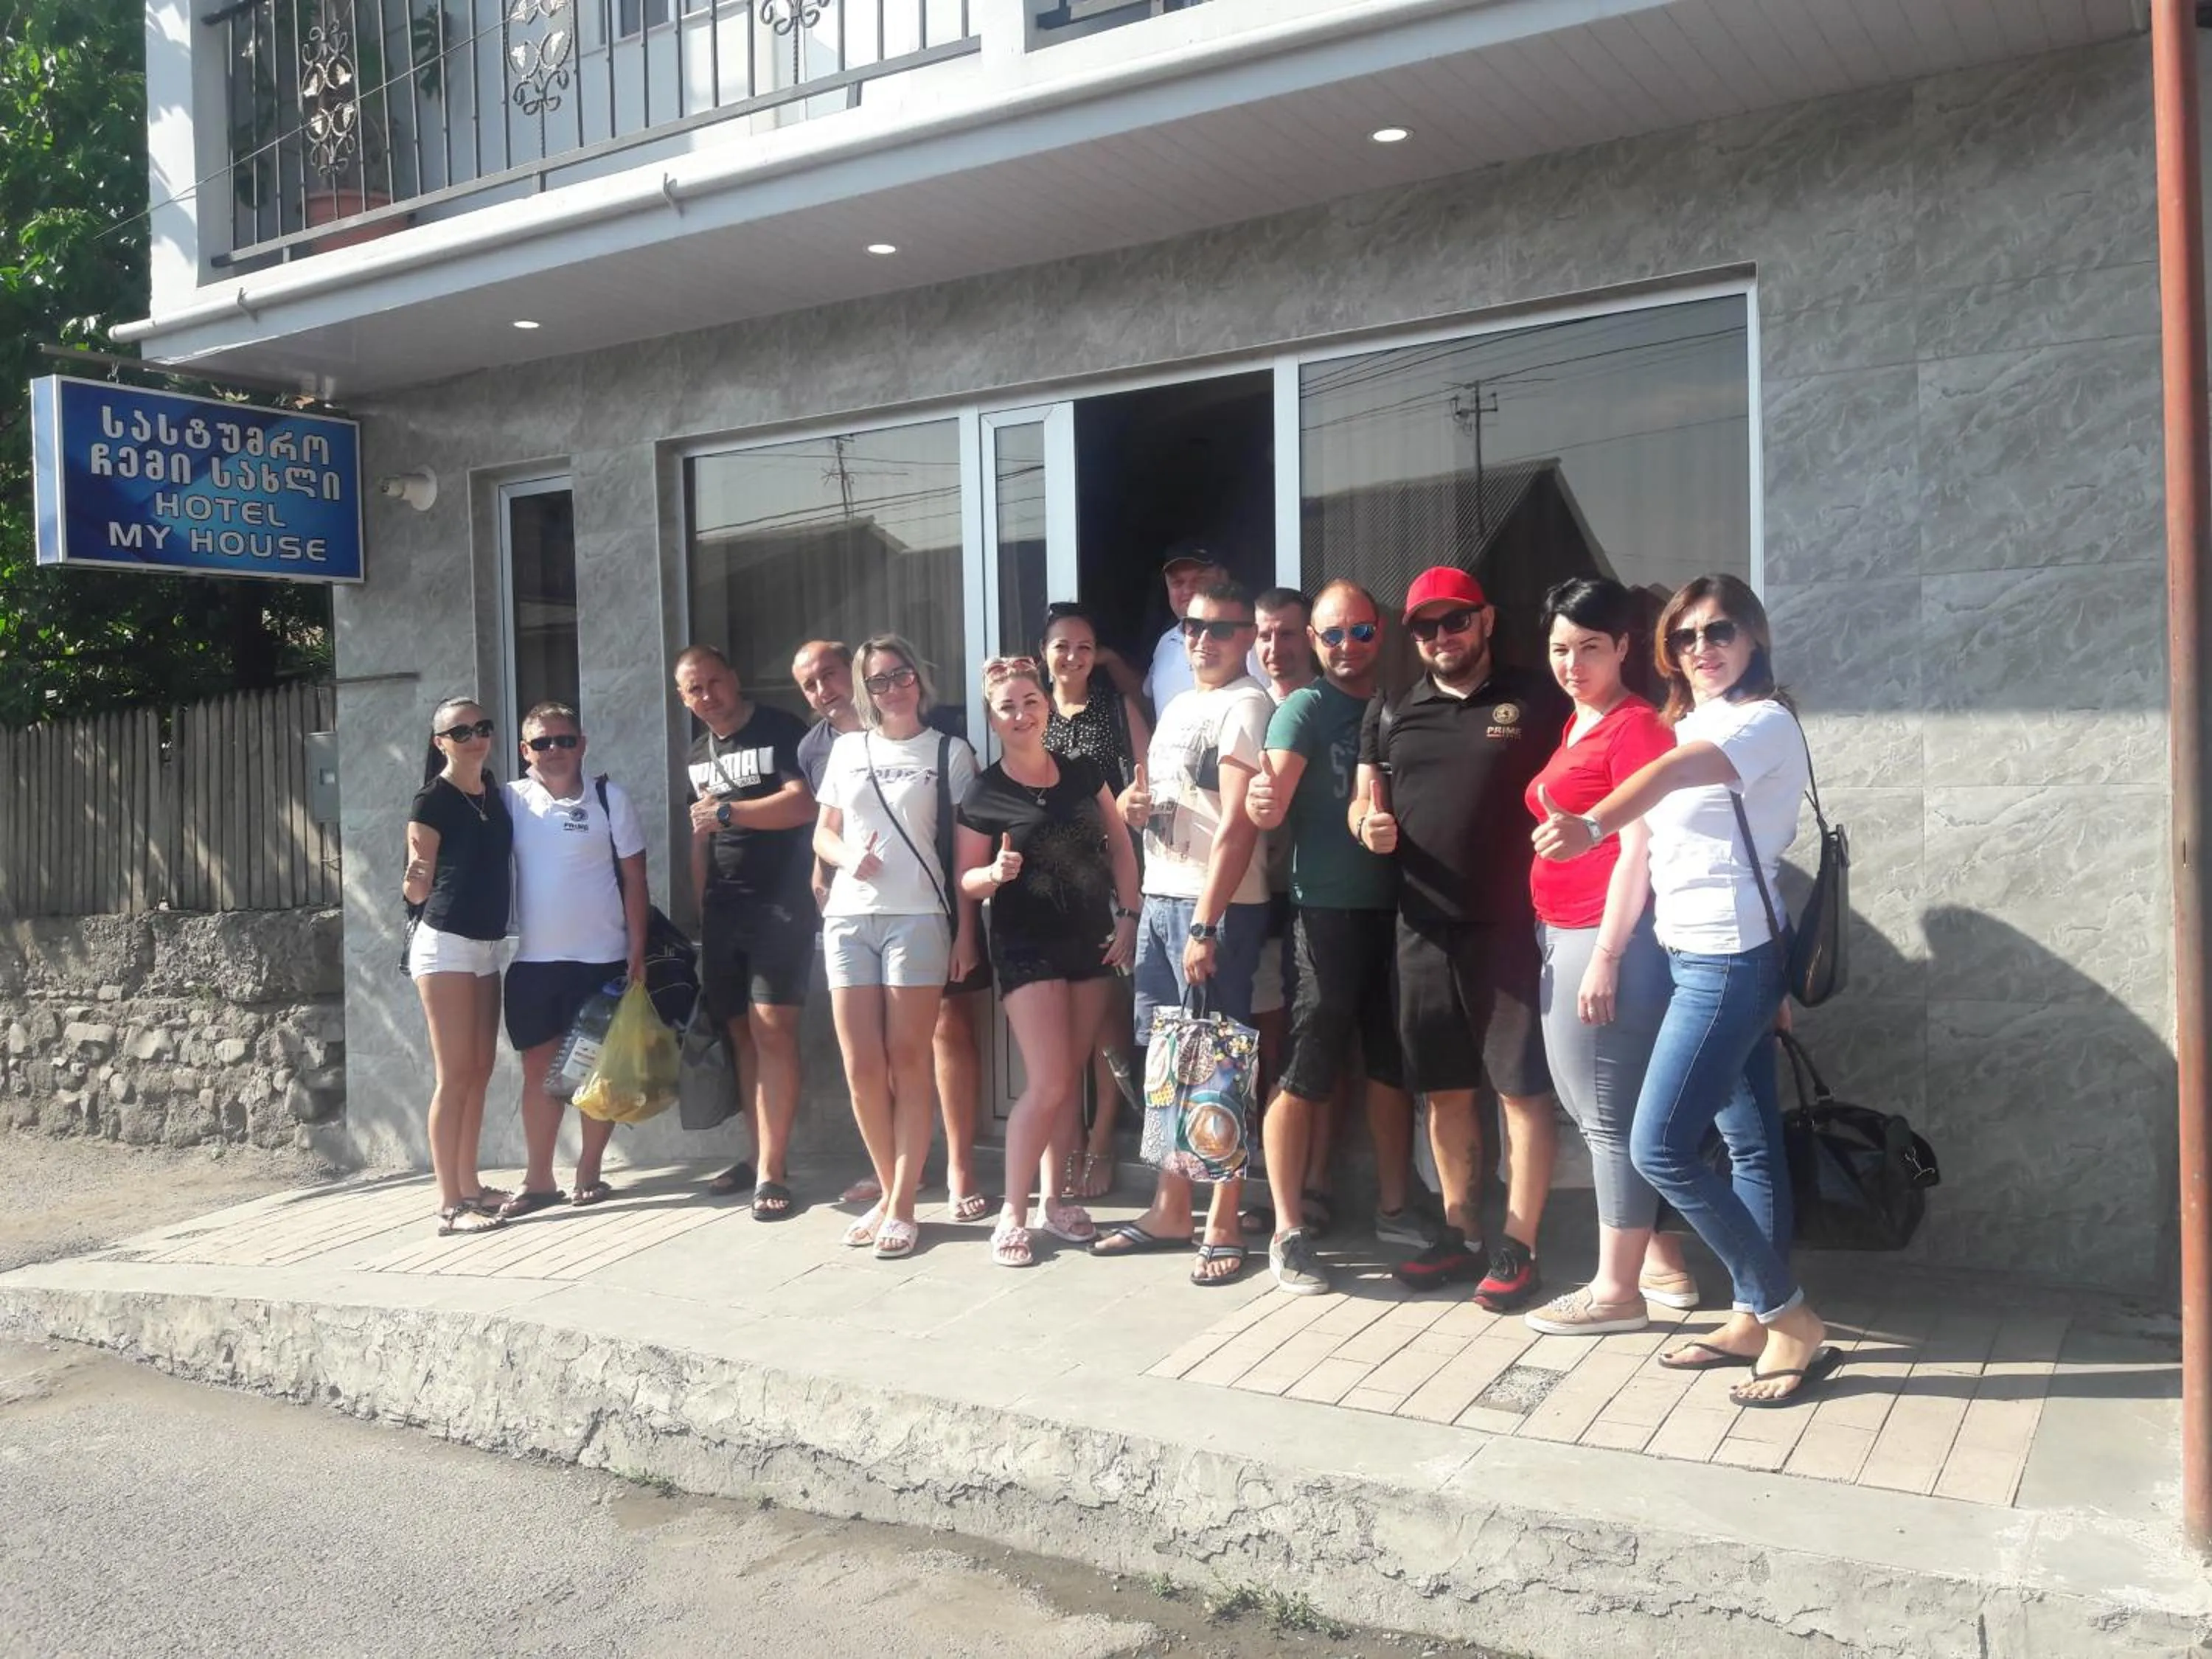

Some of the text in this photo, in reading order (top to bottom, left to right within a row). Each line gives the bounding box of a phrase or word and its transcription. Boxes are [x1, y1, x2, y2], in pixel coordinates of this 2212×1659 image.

[102, 405, 330, 466] სასტუმრო
[91, 443, 341, 501] ჩემი სახლი
[155, 492, 287, 528] HOTEL
[108, 521, 327, 562] MY HOUSE
[1486, 726, 1522, 735] PRIME
